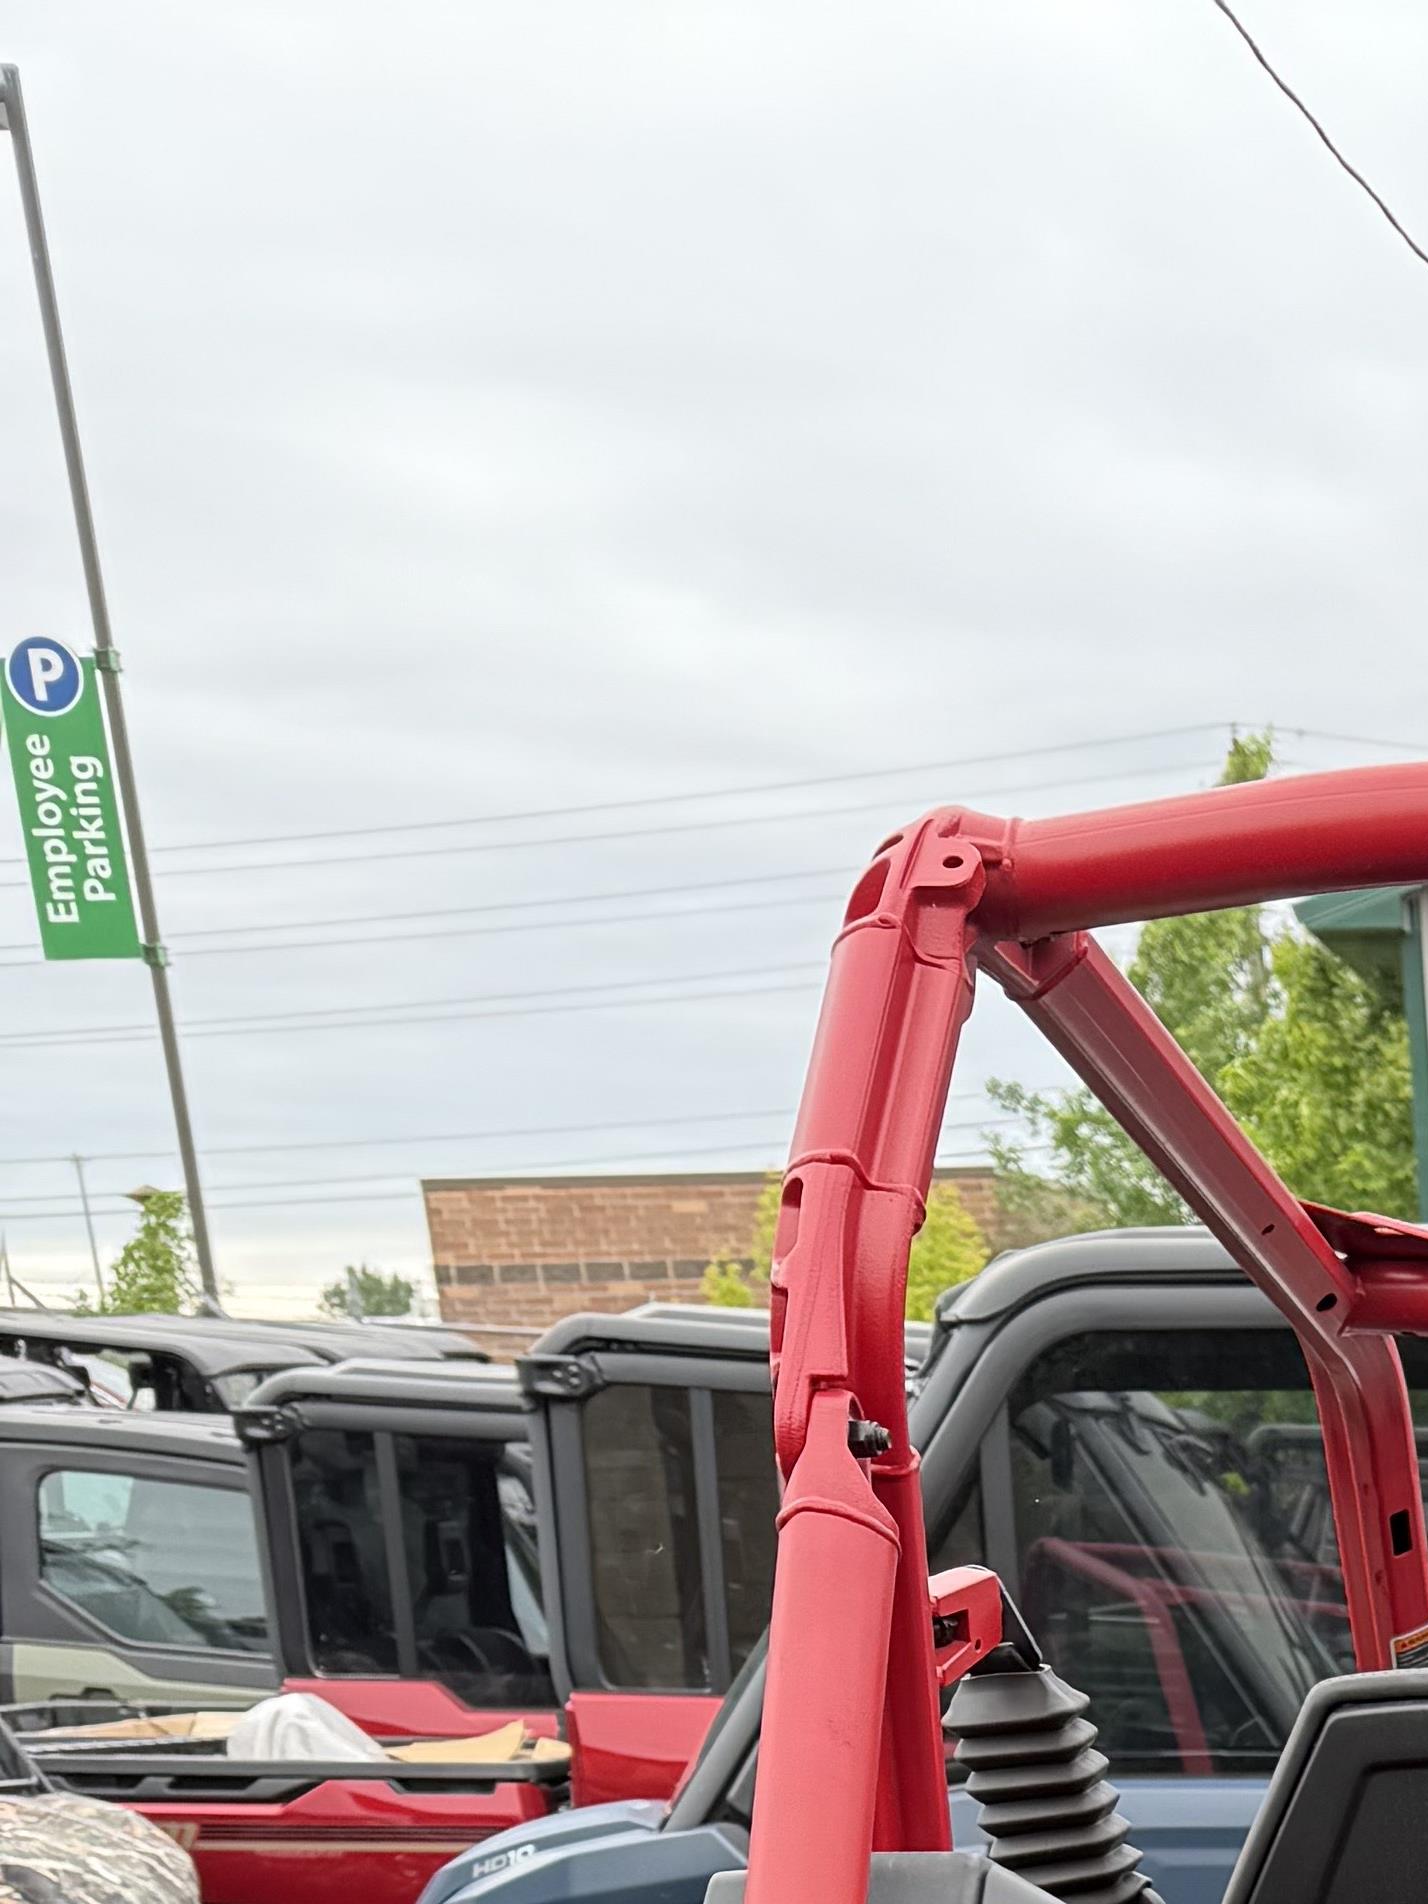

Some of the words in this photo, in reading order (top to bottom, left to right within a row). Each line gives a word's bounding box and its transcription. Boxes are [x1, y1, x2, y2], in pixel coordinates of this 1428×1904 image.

[27, 647, 64, 701] P
[26, 733, 80, 923] Employee
[69, 755, 117, 902] Parking
[472, 1843, 535, 1879] HD10
